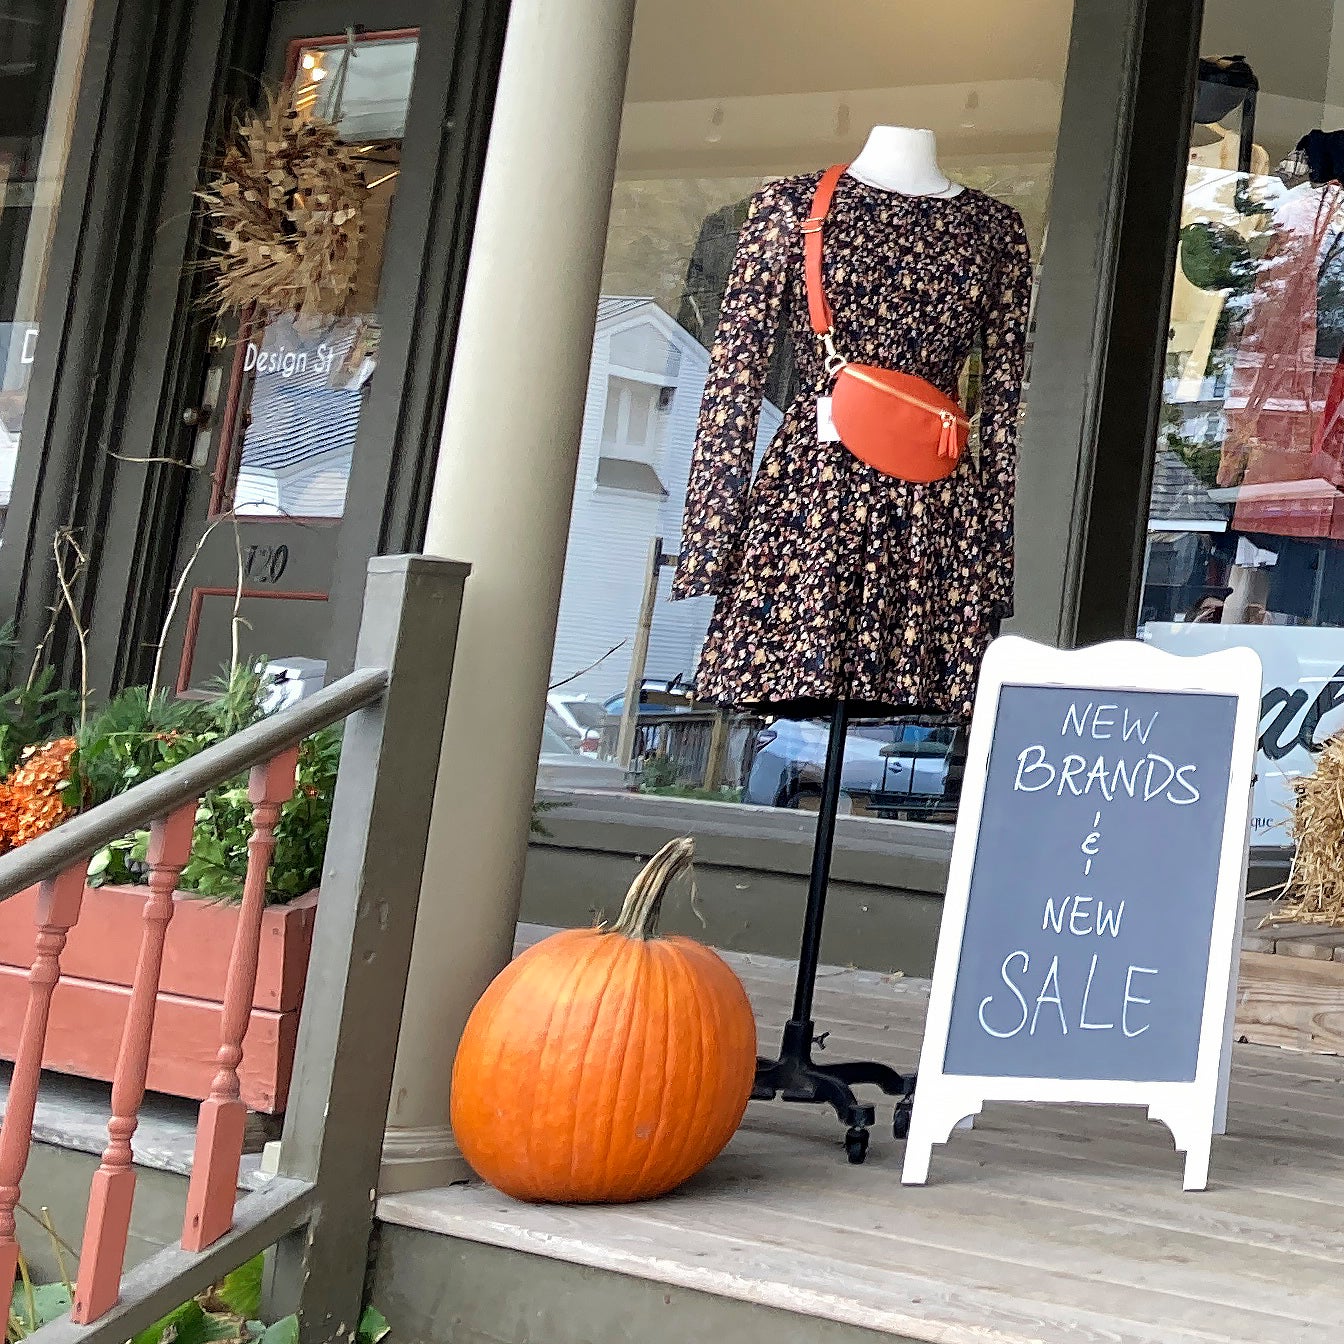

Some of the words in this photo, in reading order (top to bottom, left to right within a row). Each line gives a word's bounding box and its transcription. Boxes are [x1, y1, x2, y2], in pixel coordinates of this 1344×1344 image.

[243, 343, 307, 377] Design
[1062, 702, 1159, 745] NEW
[1014, 744, 1200, 806] BRANDS
[1042, 895, 1125, 938] NEW
[978, 950, 1159, 1038] SALE
